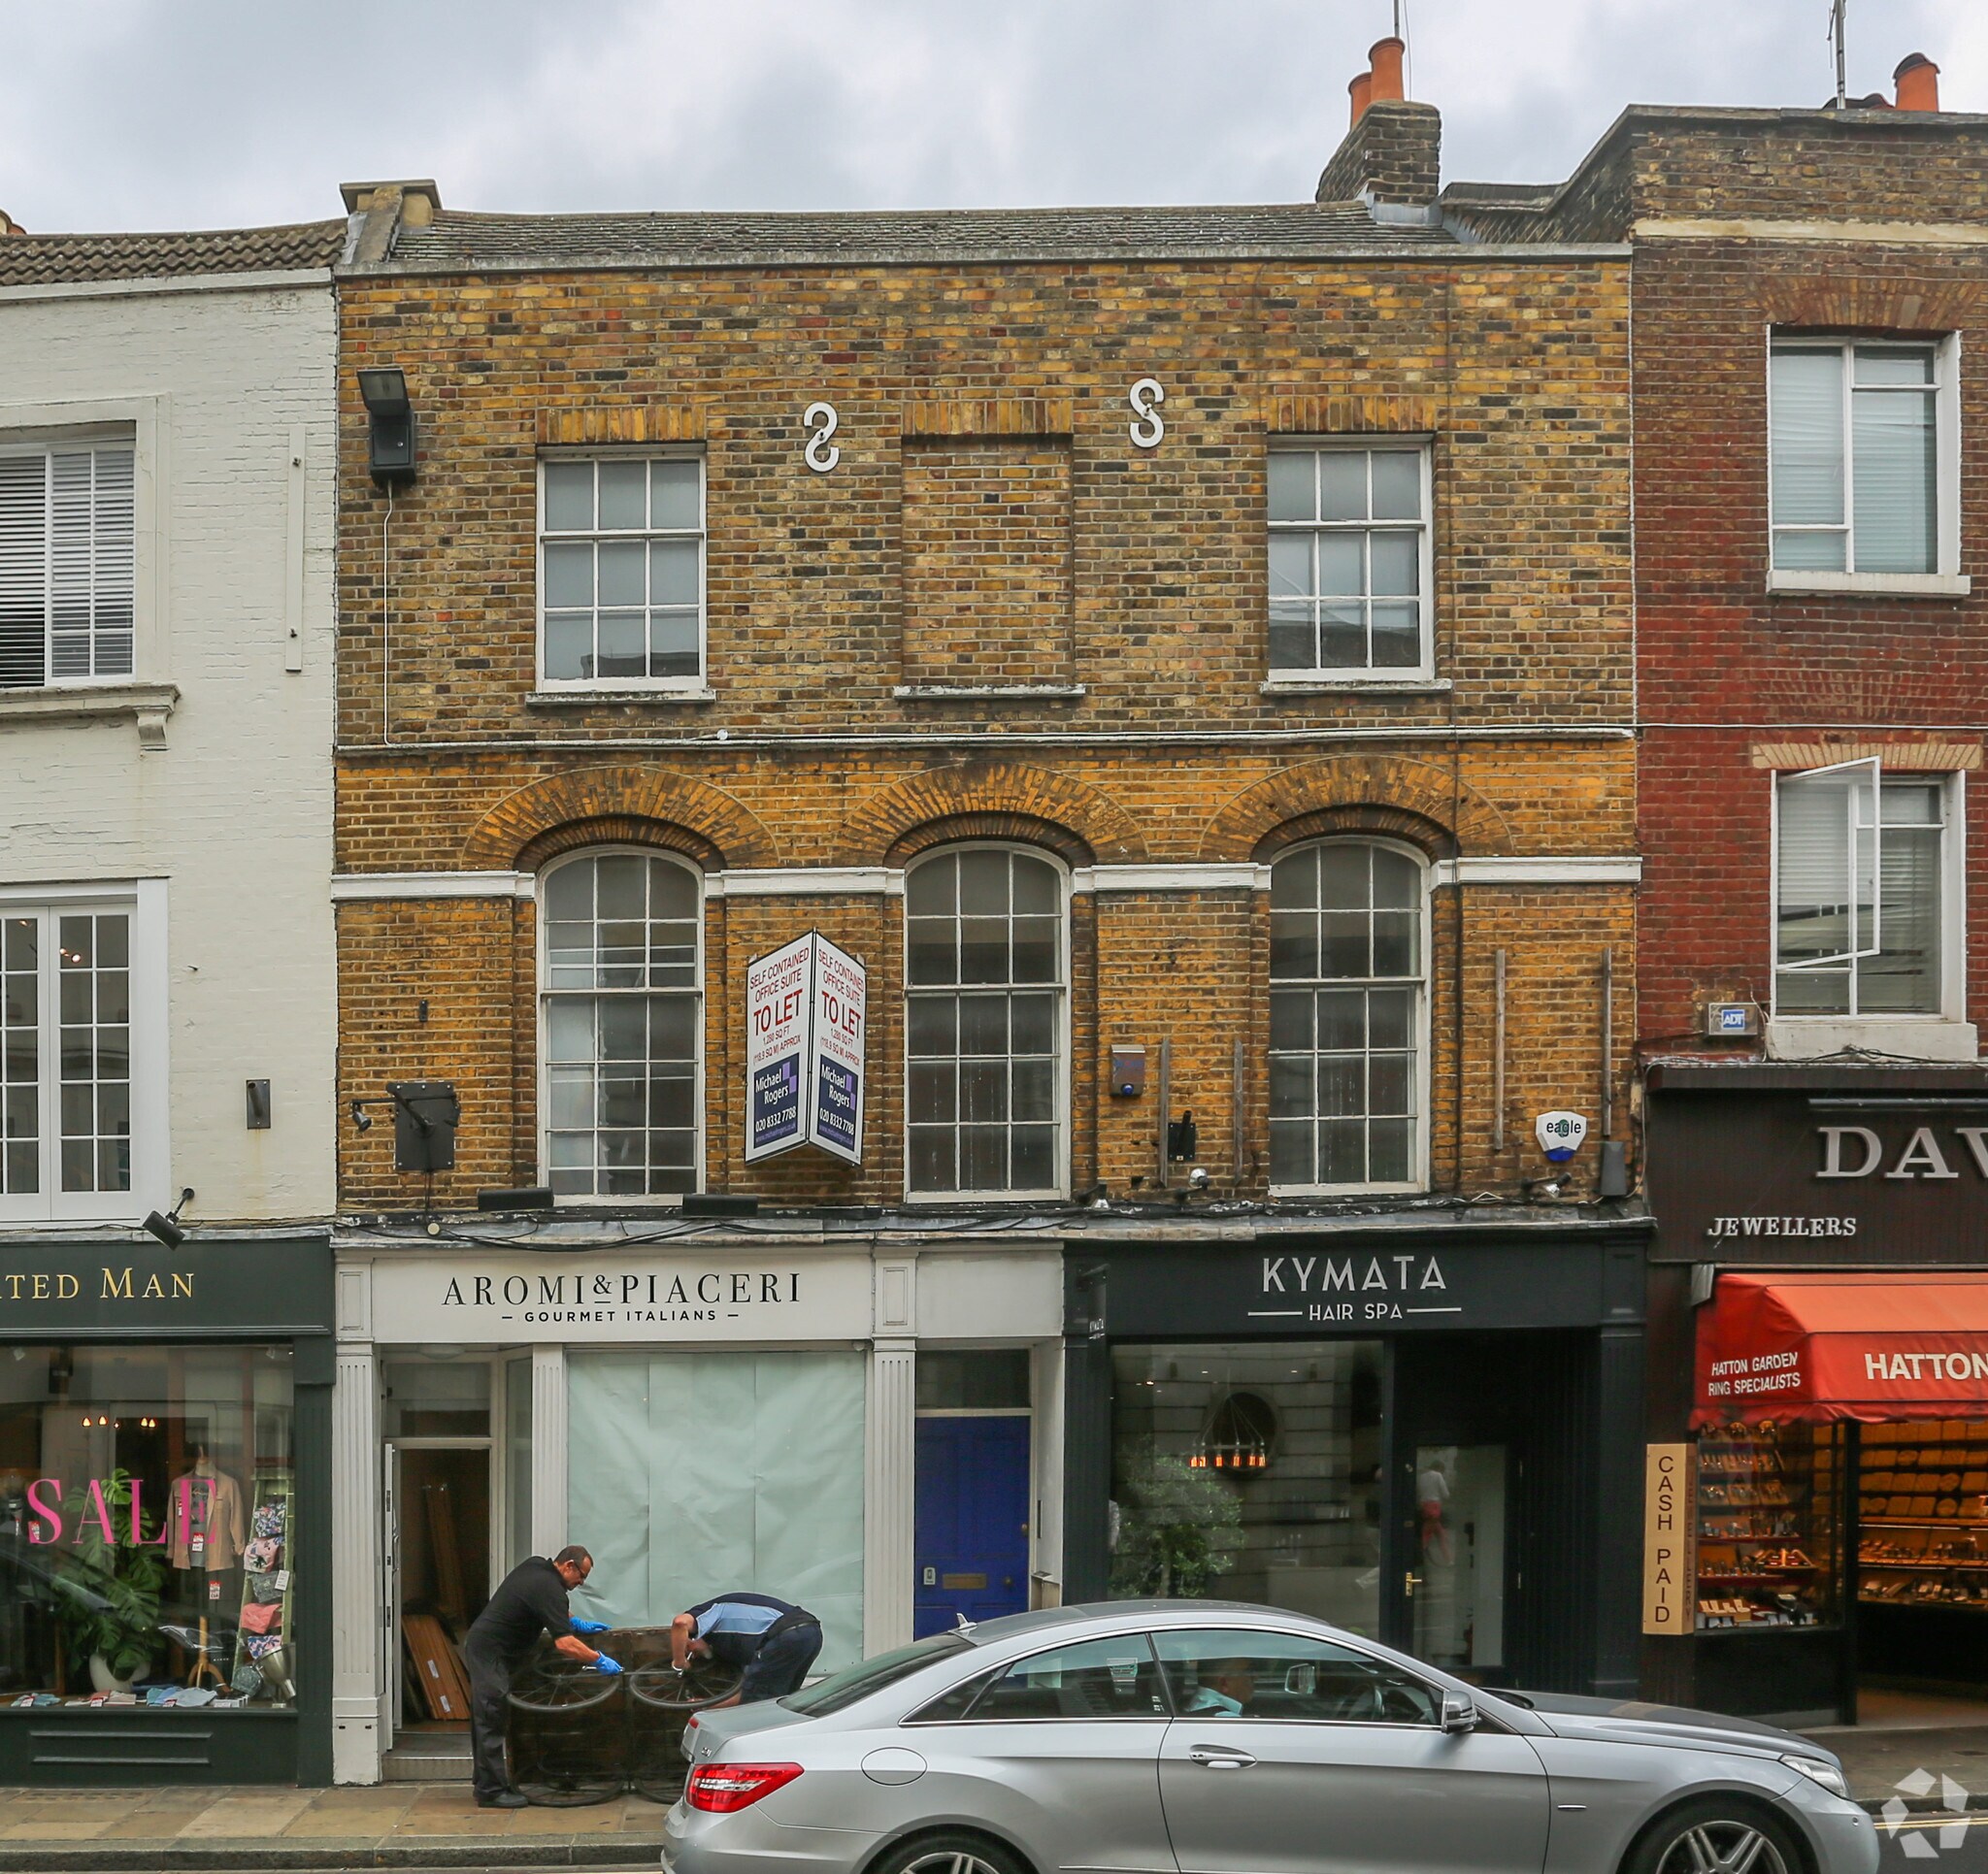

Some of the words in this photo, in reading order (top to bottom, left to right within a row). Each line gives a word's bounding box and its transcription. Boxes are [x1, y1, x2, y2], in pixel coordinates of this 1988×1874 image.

[750, 970, 767, 989] SELF
[768, 947, 809, 979] CONTAINED
[818, 948, 833, 969] SELF
[835, 960, 864, 992] CONTAINED
[755, 979, 779, 1003] OFFICE
[780, 968, 802, 989] SUITE
[823, 970, 845, 995] OFFICE
[845, 984, 860, 1006] SUITE
[753, 1005, 771, 1036] TO
[776, 988, 803, 1026] LET
[821, 990, 839, 1024] TO
[842, 1003, 861, 1038] LET
[1723, 1014, 1744, 1026] ADT
[776, 1029, 782, 1039] SQ
[783, 1025, 790, 1036] FT
[780, 1034, 801, 1051] APPROX
[755, 1069, 781, 1093] Michael
[821, 1064, 845, 1089] Michael
[764, 1085, 788, 1104] Rogers
[828, 1085, 850, 1108] Rogers
[755, 1119, 766, 1133] 020
[767, 1112, 781, 1128] 8332
[819, 1107, 829, 1122] 020
[830, 1113, 842, 1130] 8332
[1546, 1120, 1581, 1137] eagle
[1706, 1217, 1857, 1237] JEWELLERS
[0, 1274, 80, 1299] TED
[1262, 1255, 1447, 1293] KYMATA
[524, 1310, 615, 1322] GOURMET
[626, 1308, 716, 1321] ITALIANS
[1309, 1304, 1354, 1321] HAIR
[1365, 1303, 1404, 1321] SPA
[1711, 1360, 1748, 1376] HATTON
[1752, 1352, 1798, 1371] GARDEN
[1865, 1353, 1988, 1380] HATTON
[1708, 1381, 1731, 1397] RING
[1734, 1372, 1801, 1395] SPECIALISTS
[1658, 1456, 1673, 1530] CASH
[27, 1479, 217, 1544] SALE
[1655, 1549, 1672, 1623] PAID
